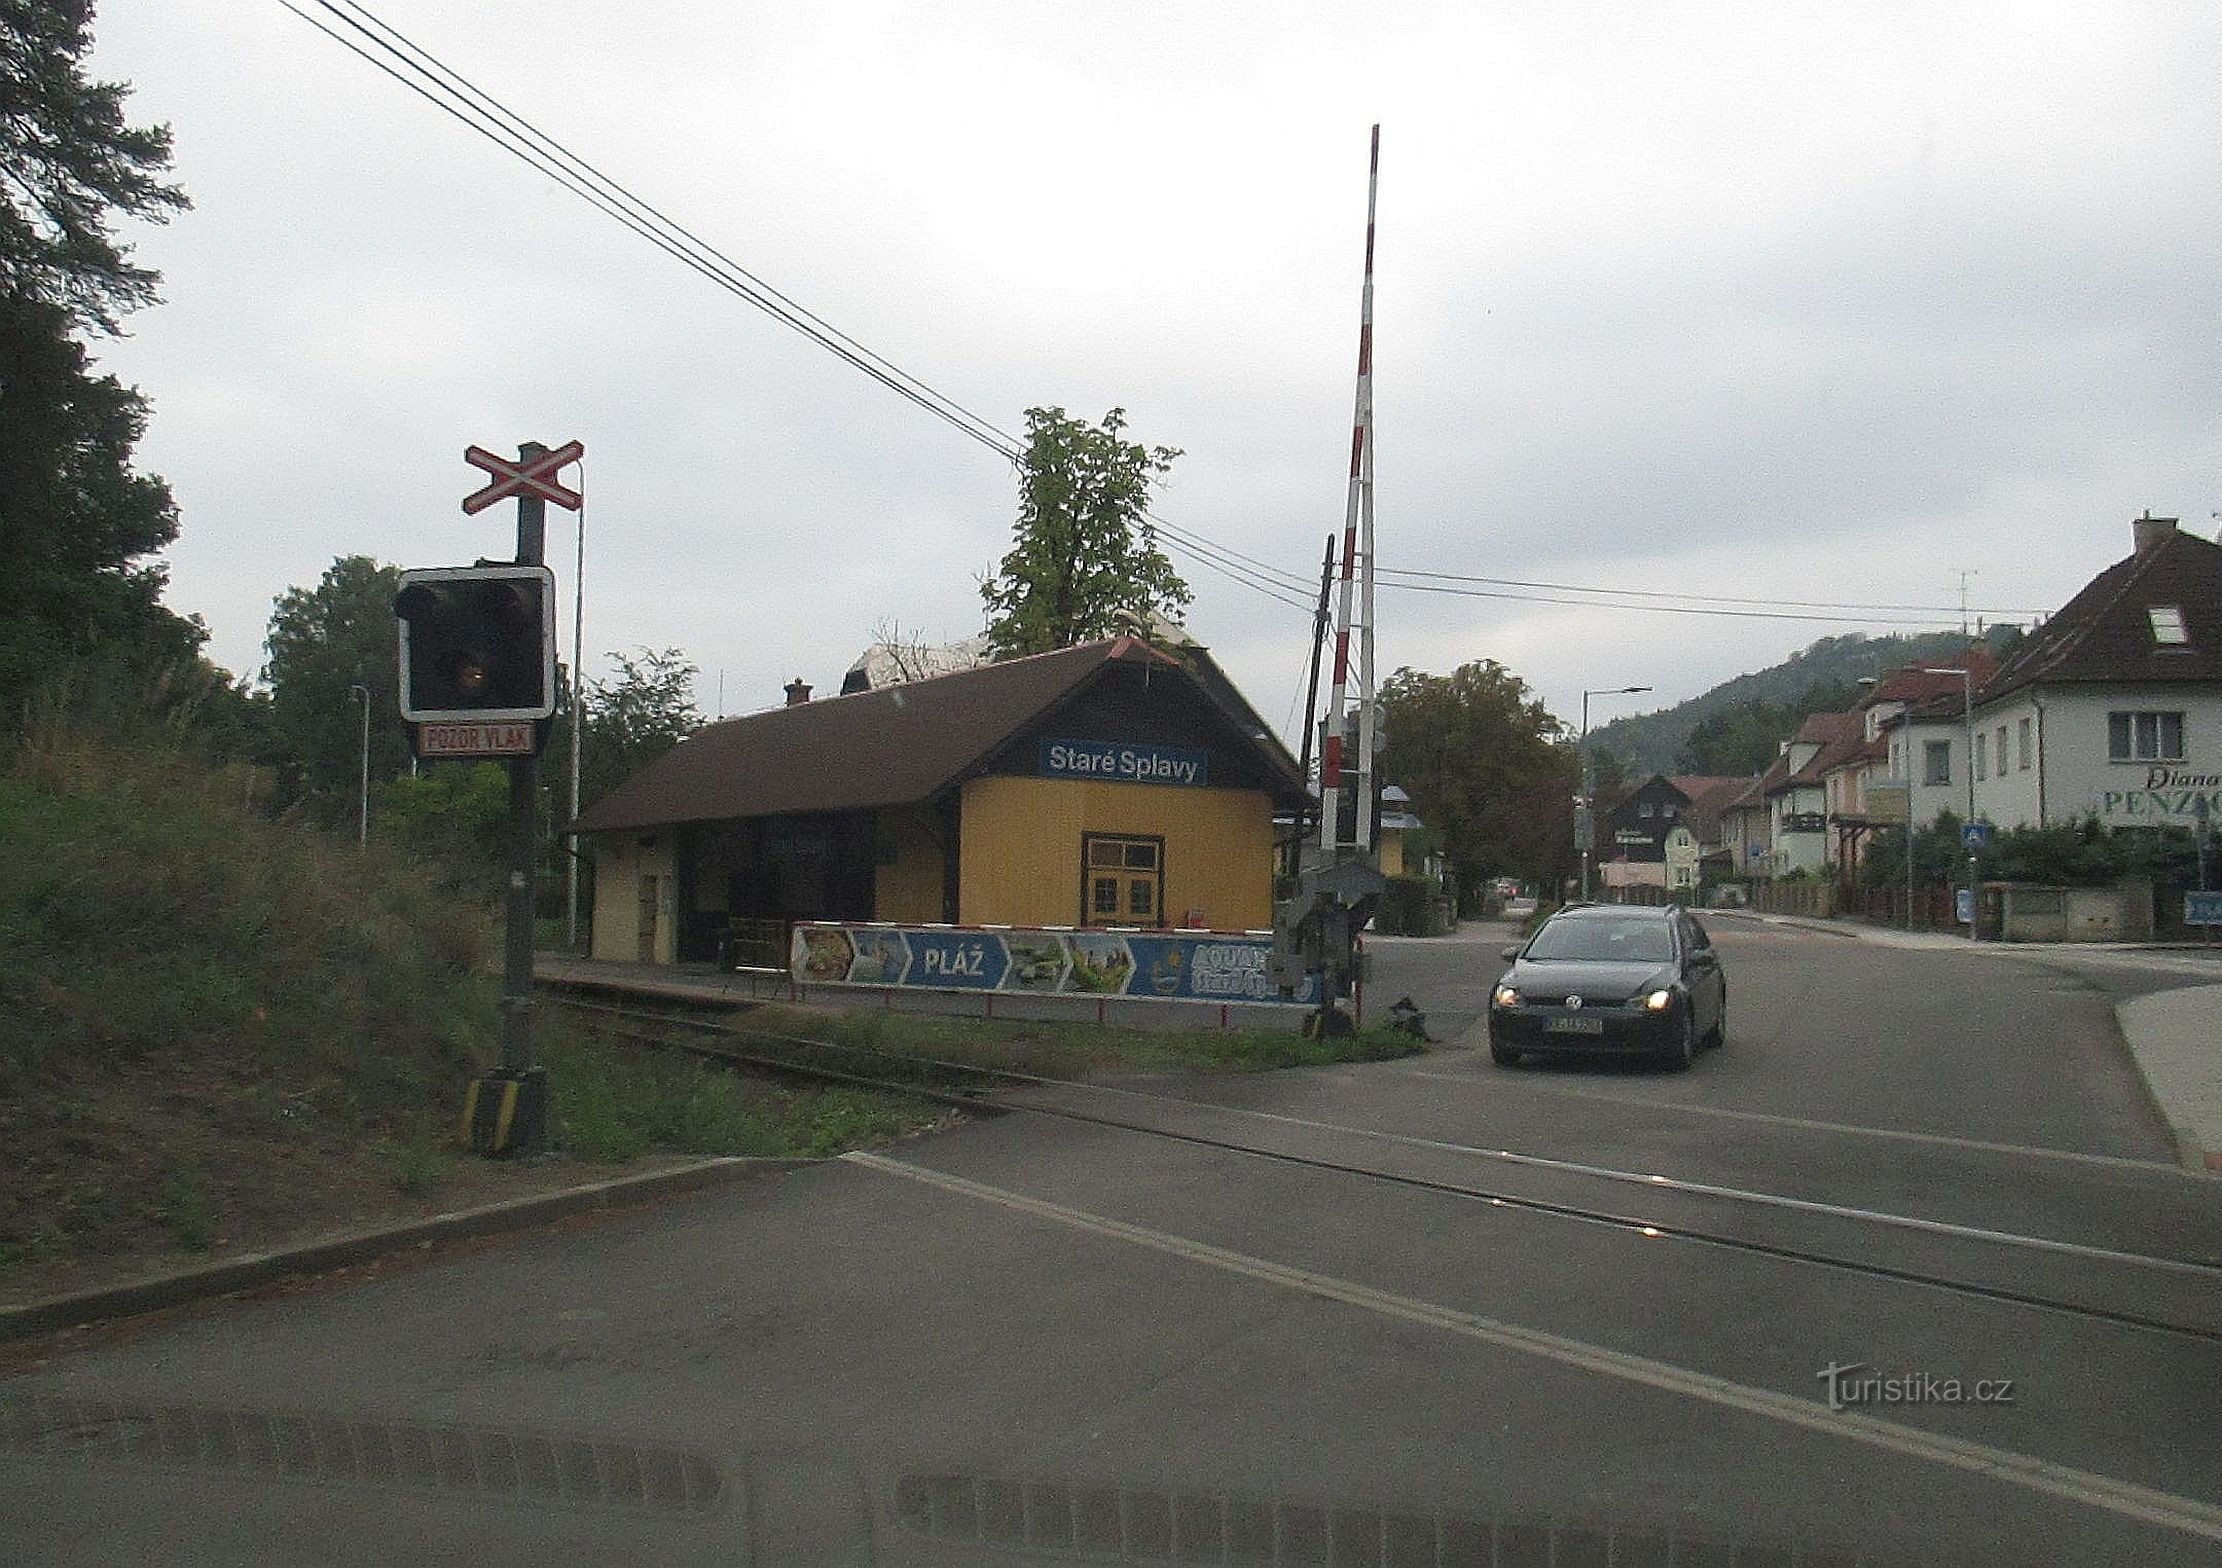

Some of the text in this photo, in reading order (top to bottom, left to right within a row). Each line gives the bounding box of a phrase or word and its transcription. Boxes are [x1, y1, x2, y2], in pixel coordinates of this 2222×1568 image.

[427, 727, 530, 749] POZOR VLAK
[1050, 745, 1198, 783] Staré Splavy
[2104, 790, 2222, 815] PENZ
[925, 943, 984, 976] PLÁŽ
